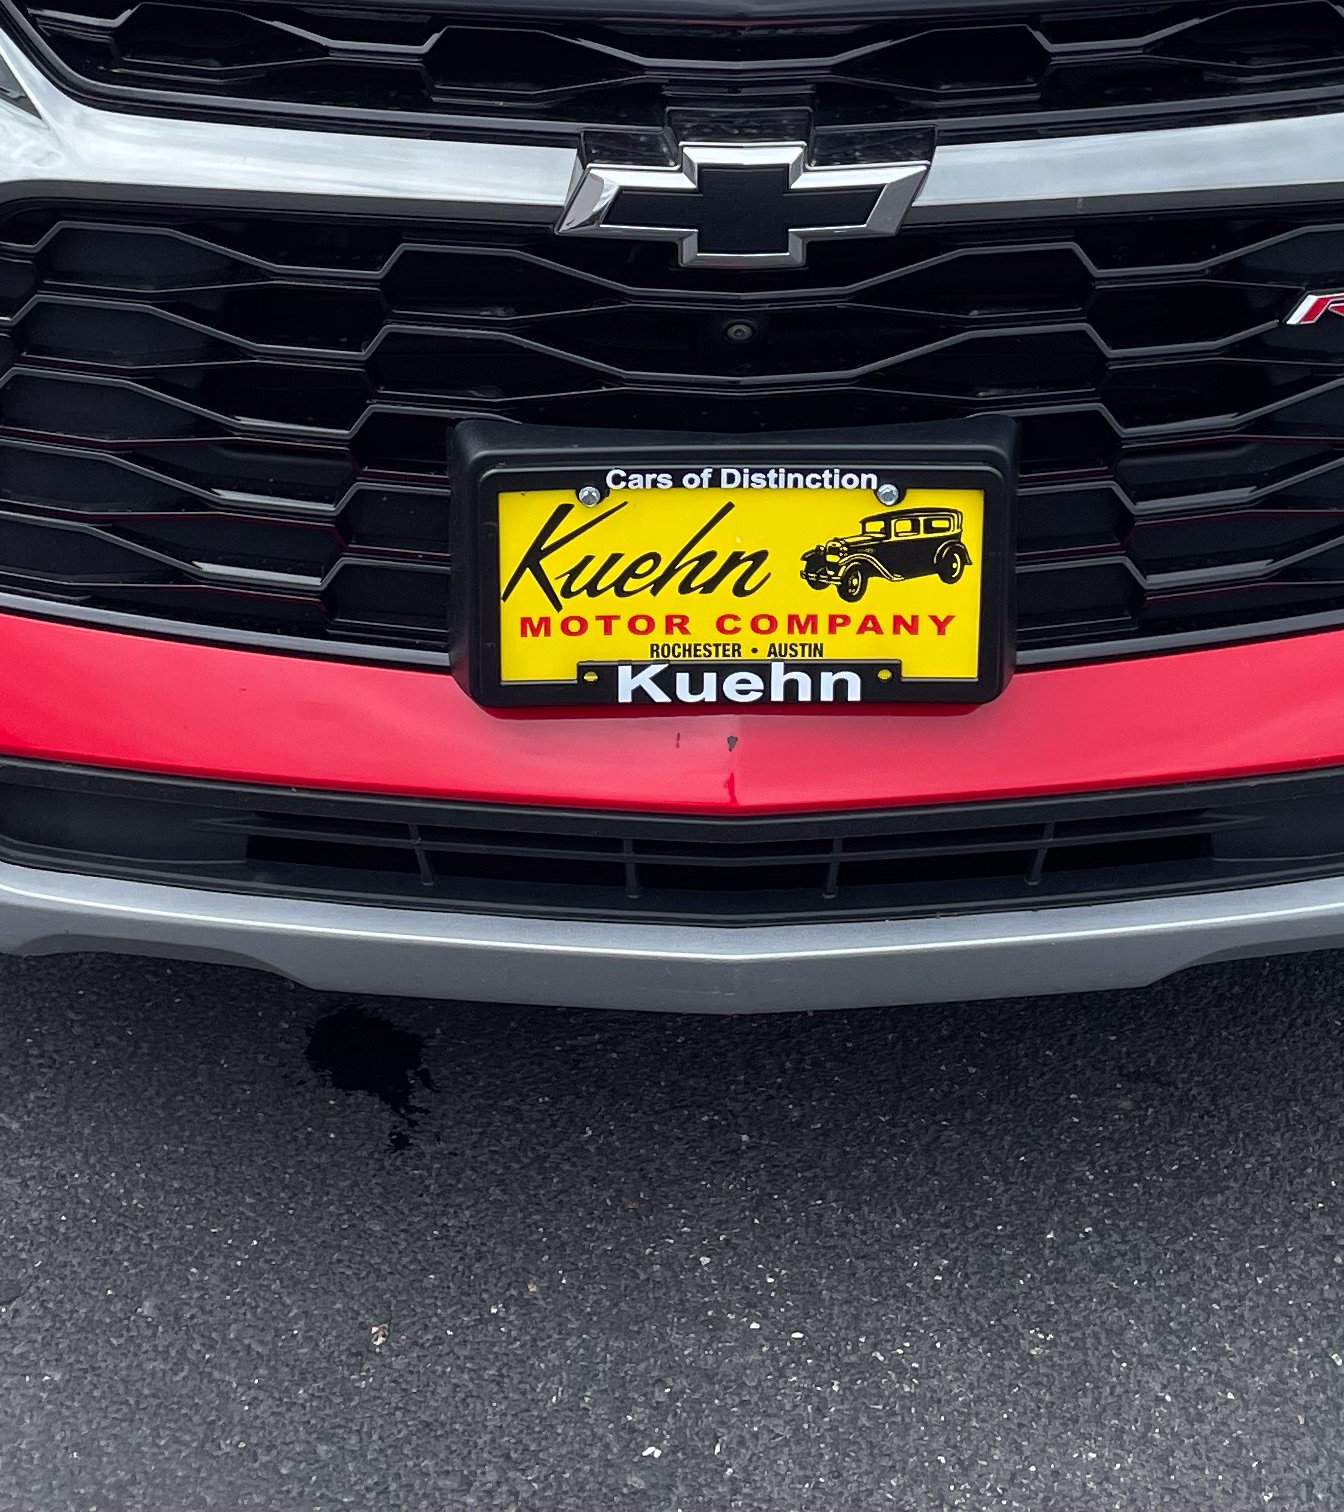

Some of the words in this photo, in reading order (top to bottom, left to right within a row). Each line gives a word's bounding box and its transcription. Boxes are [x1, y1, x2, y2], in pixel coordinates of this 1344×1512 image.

[606, 468, 673, 489] Cars
[683, 468, 712, 489] of
[720, 468, 878, 489] Distinction
[500, 501, 772, 613] Kuehn
[520, 614, 691, 637] MOTOR
[715, 613, 956, 636] COMPANY
[649, 642, 742, 658] ROCHESTER
[767, 642, 824, 658] AUSTIN
[617, 661, 862, 703] Kuehn
